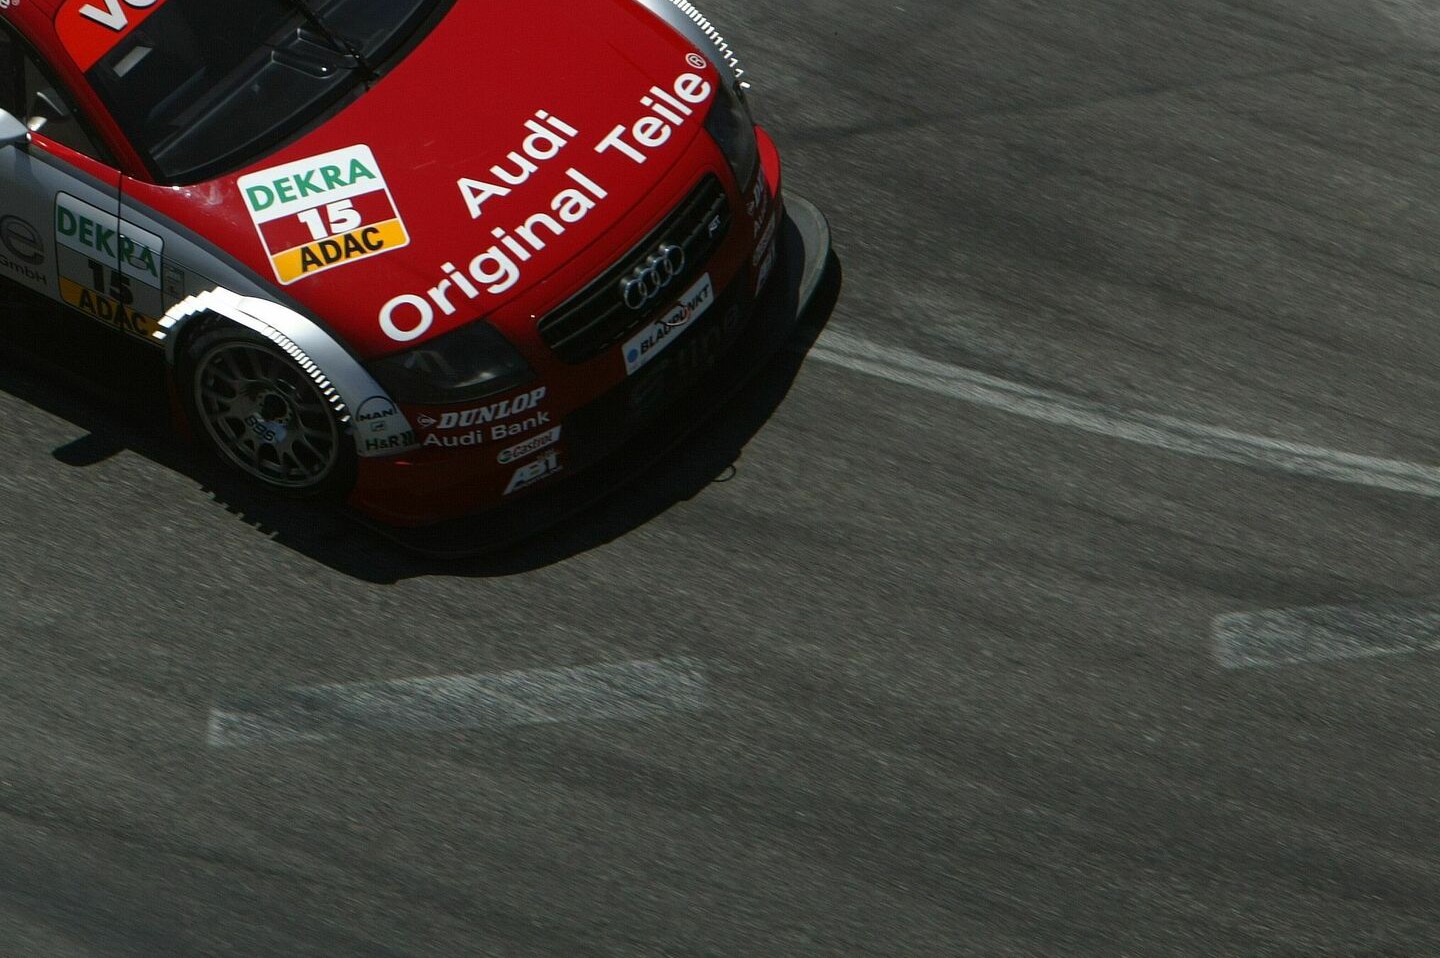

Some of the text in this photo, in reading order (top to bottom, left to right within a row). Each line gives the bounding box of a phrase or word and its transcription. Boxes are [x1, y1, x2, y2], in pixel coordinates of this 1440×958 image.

[245, 158, 377, 213] DEKRA
[457, 109, 579, 219] Audi
[57, 205, 158, 277] DEKRA
[296, 199, 363, 241] 15
[299, 225, 385, 273] ADAC
[378, 168, 608, 343] Original
[87, 258, 134, 304] 15
[79, 288, 149, 336] ADAC
[639, 283, 711, 355] BLAUPUNKT
[244, 415, 276, 442] BBS
[360, 408, 393, 420] MAN
[423, 411, 551, 447] Audi Bank
[436, 386, 547, 429] DUNLOP
[512, 430, 553, 459] Castrol
